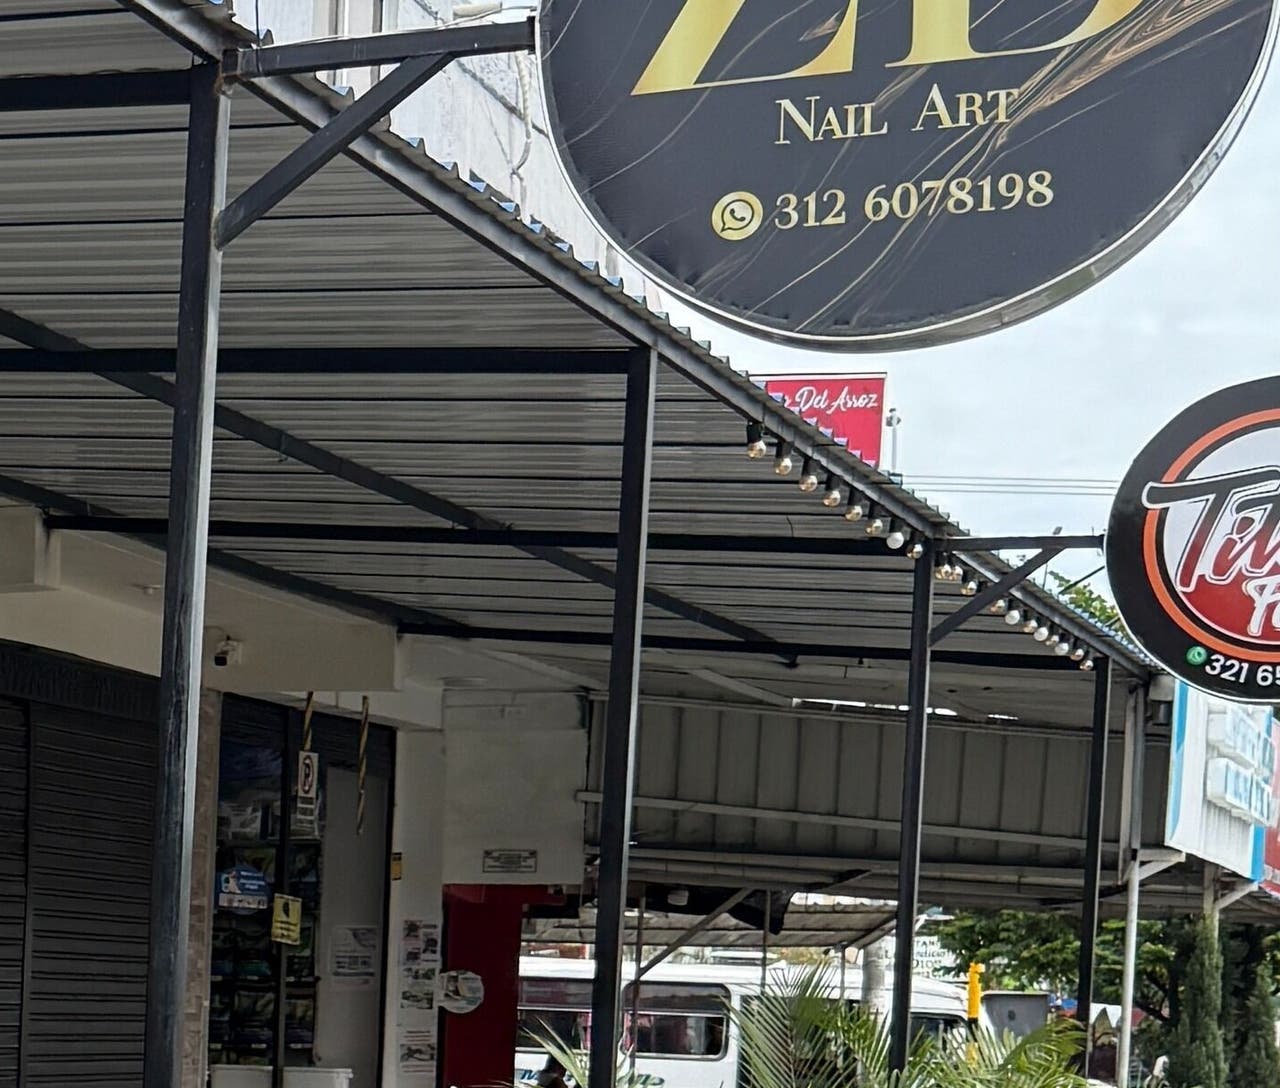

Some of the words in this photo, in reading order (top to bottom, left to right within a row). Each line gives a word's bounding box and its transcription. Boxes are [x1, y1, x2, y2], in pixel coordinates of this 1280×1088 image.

[774, 188, 847, 230] 312
[864, 170, 1056, 222] 6078198
[796, 386, 828, 412] Del
[1205, 654, 1249, 684] 321
